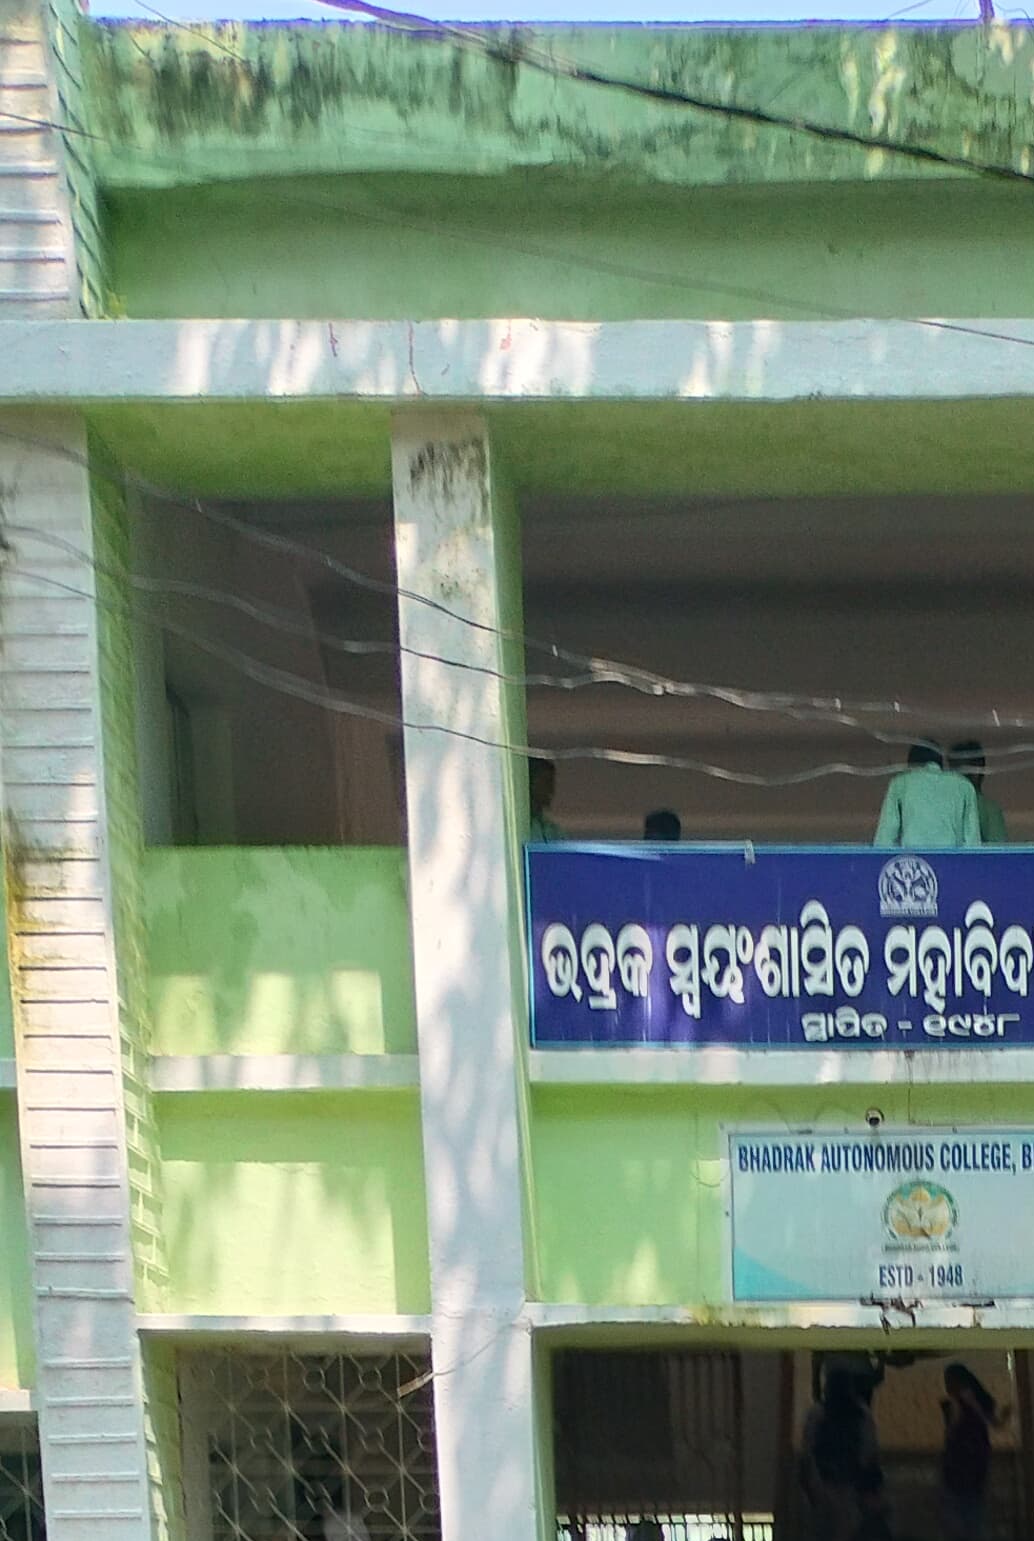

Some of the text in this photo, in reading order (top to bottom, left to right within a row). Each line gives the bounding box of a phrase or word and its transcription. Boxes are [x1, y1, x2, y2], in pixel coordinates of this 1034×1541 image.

[542, 922, 653, 1010] ଭଦ୍ରକ
[739, 1144, 815, 1172] BHADRAK
[821, 1143, 935, 1172] AUTONOMOUS
[940, 1143, 1017, 1175] COLLEGE,
[879, 1264, 914, 1288] ESTD
[929, 1263, 963, 1288] 1948
